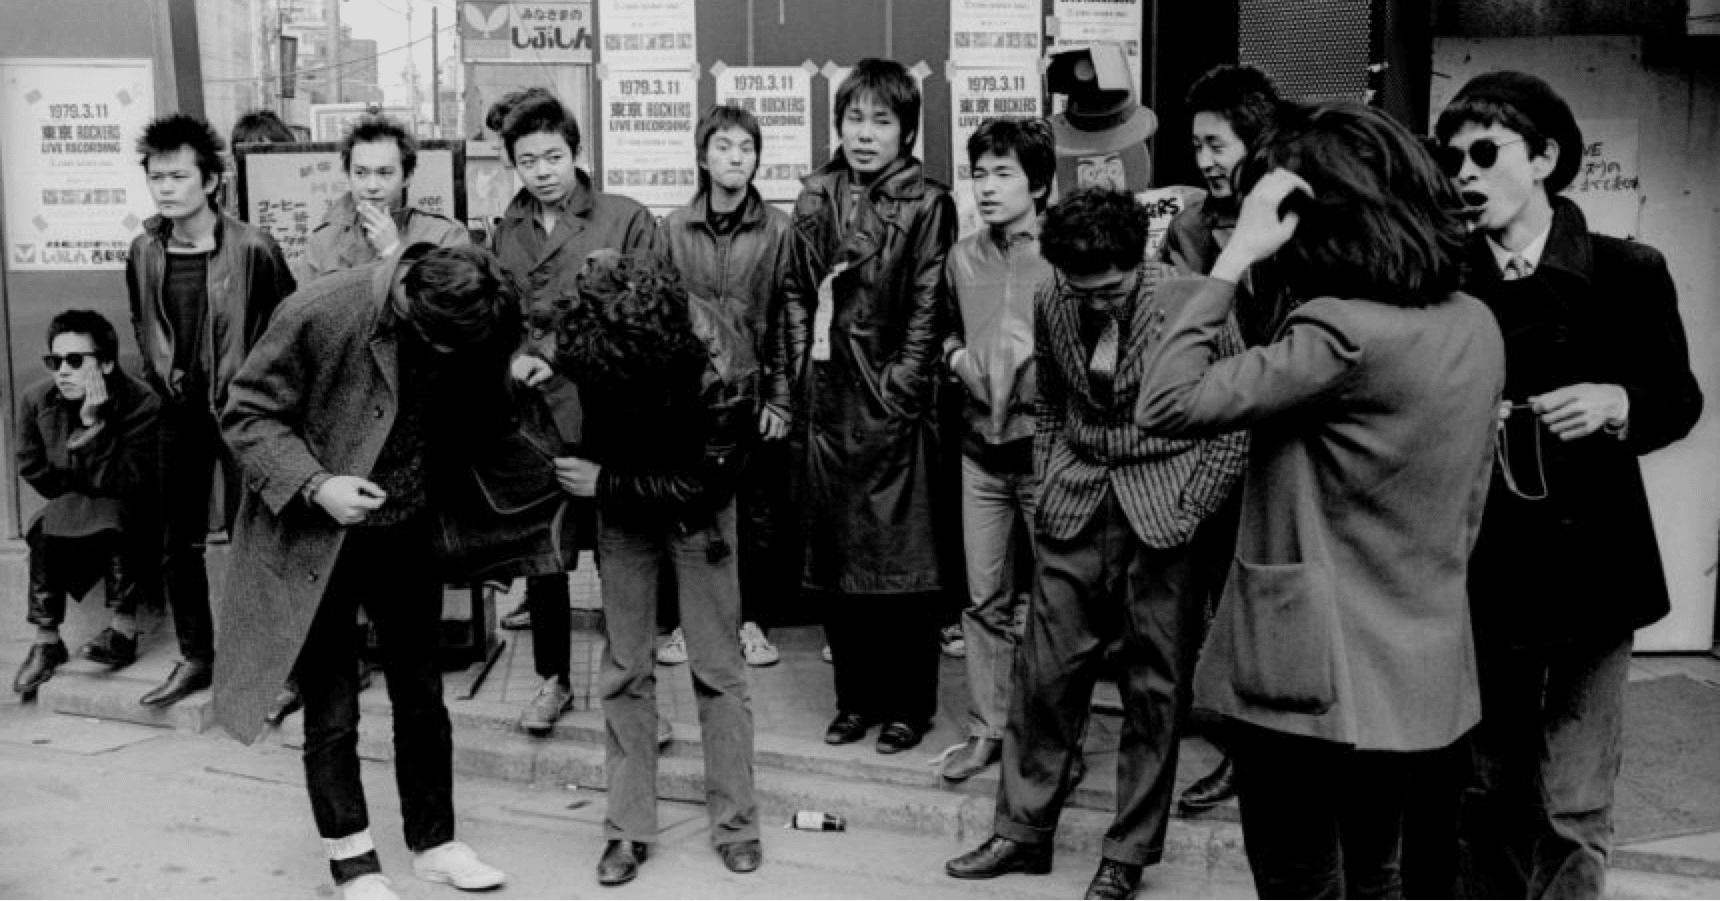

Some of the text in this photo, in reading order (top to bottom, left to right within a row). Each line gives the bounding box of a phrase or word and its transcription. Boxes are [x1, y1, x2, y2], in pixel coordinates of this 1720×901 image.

[521, 8, 583, 21] みなさまの
[511, 26, 593, 49] しぶしん
[619, 79, 680, 95] 1979.3.11
[734, 75, 793, 91] 1979.3.11
[967, 75, 1024, 91] 1979.3.11
[49, 103, 108, 119] 1979.3.11
[610, 102, 691, 118] 東京 ROCKERS
[760, 96, 805, 113] ROCKERS
[959, 96, 1037, 114] 東京 ROCKERS
[609, 120, 691, 132] LIVE RECORDING
[757, 115, 805, 126] CORDING
[41, 125, 121, 140] 東京 ROCKERS
[41, 141, 121, 154] LIVE RECORDING
